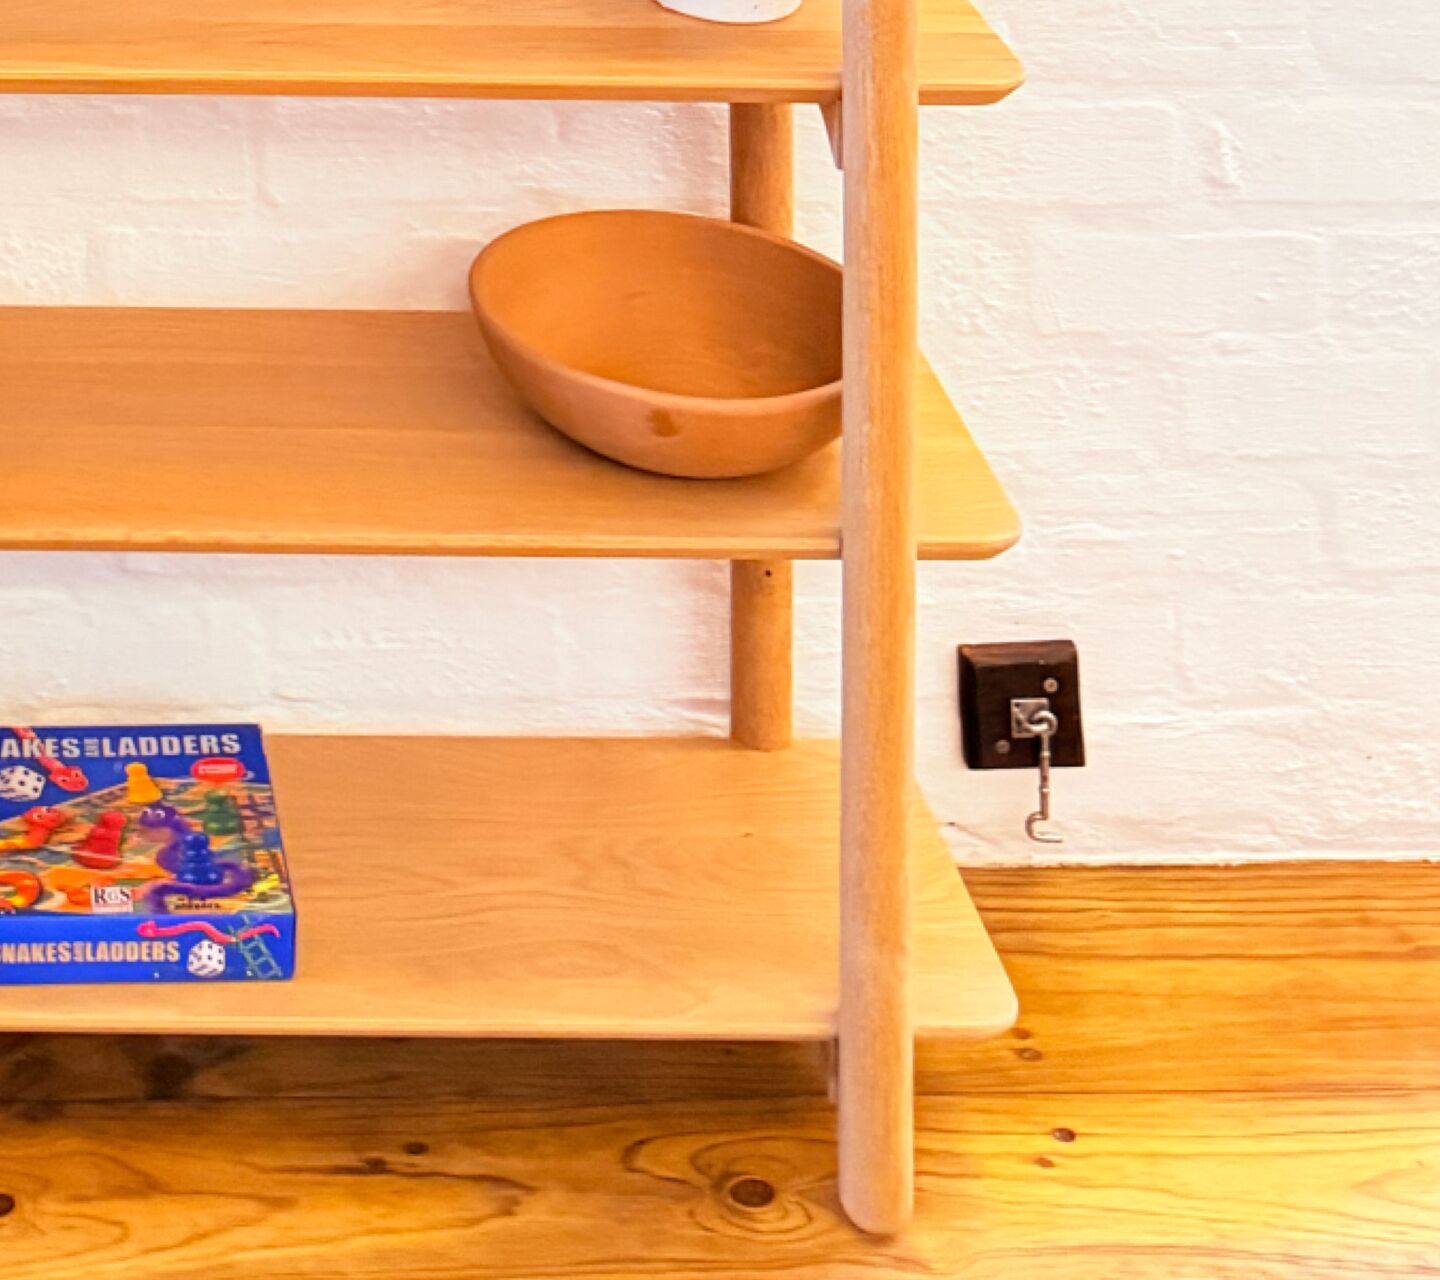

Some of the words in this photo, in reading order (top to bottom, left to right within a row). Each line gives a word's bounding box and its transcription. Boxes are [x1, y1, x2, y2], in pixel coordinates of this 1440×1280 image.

[103, 733, 242, 758] LADDERS
[93, 888, 132, 904] RGS
[86, 940, 180, 963] LADDERS
